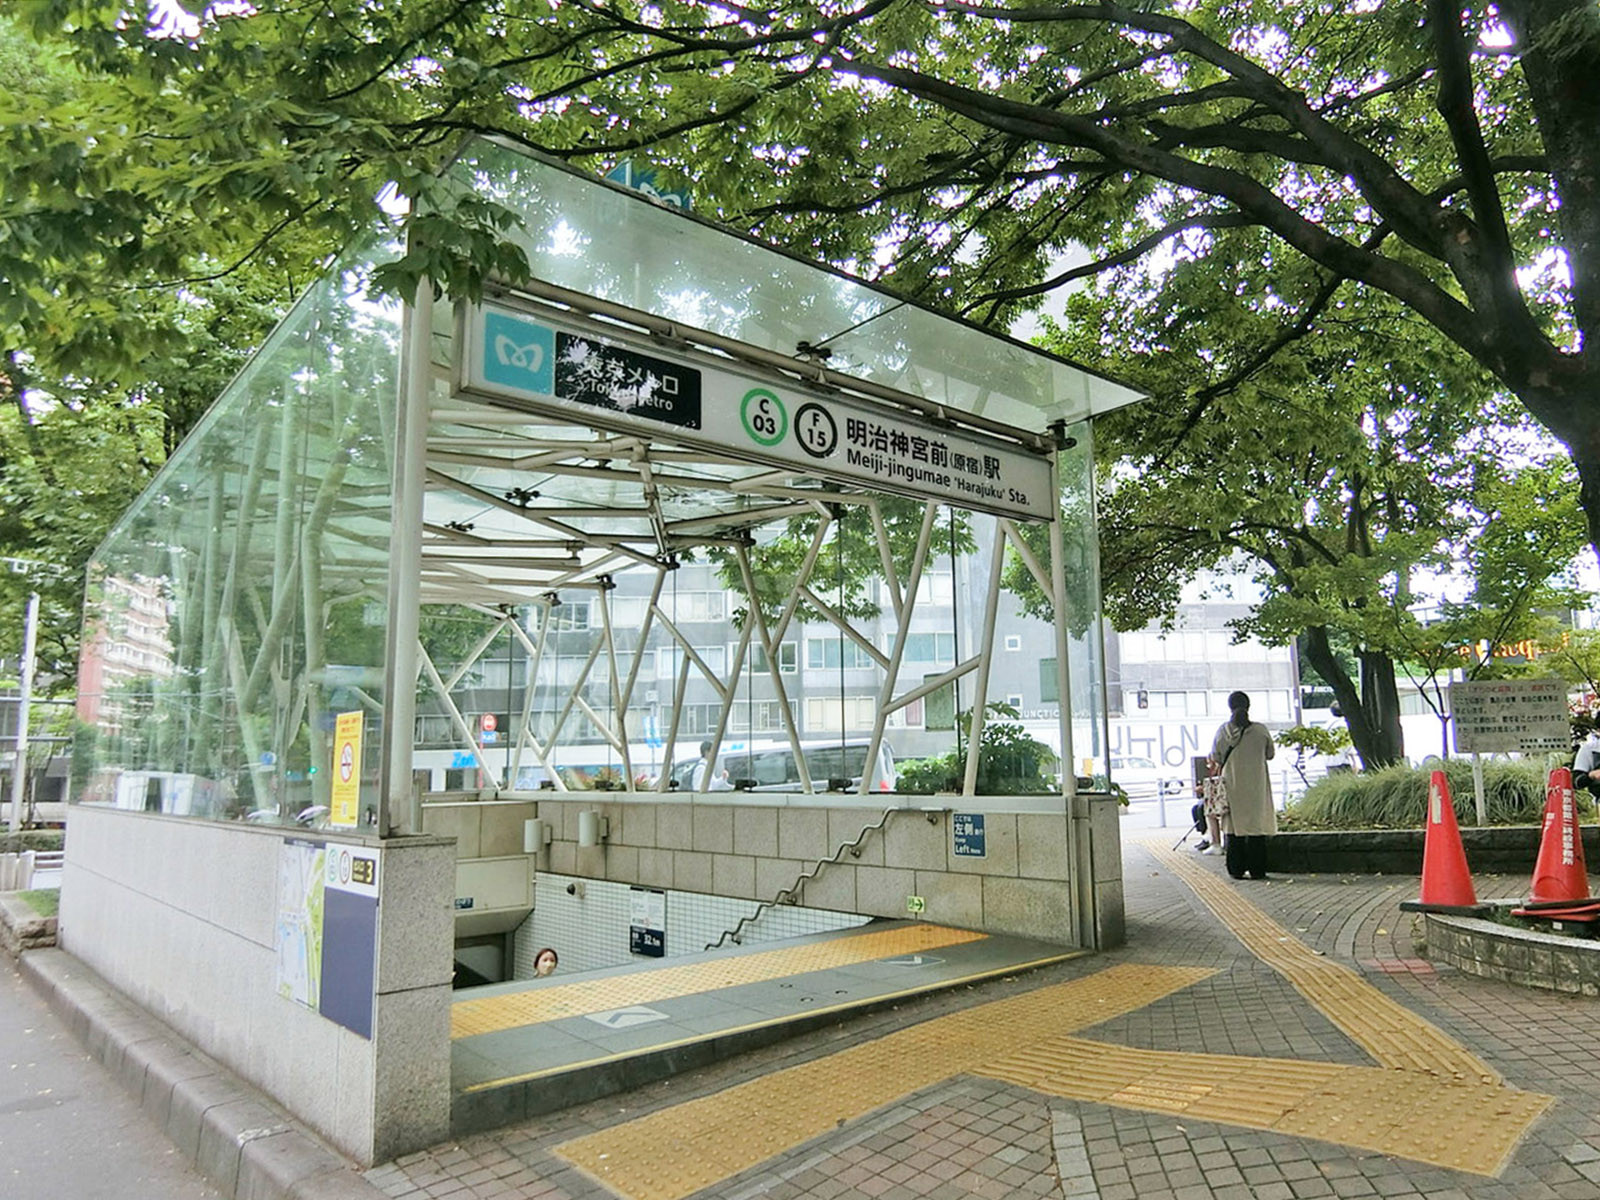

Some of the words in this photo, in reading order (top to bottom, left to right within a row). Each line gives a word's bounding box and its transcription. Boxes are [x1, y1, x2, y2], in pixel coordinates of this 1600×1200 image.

[759, 398, 769, 414] C
[753, 414, 776, 435] 03
[812, 412, 820, 427] F
[807, 428, 827, 447] 15
[847, 448, 951, 487] Meiji-jingumae
[1008, 487, 1030, 506] Sta.
[955, 845, 970, 854] Left
[366, 860, 373, 883] 3
